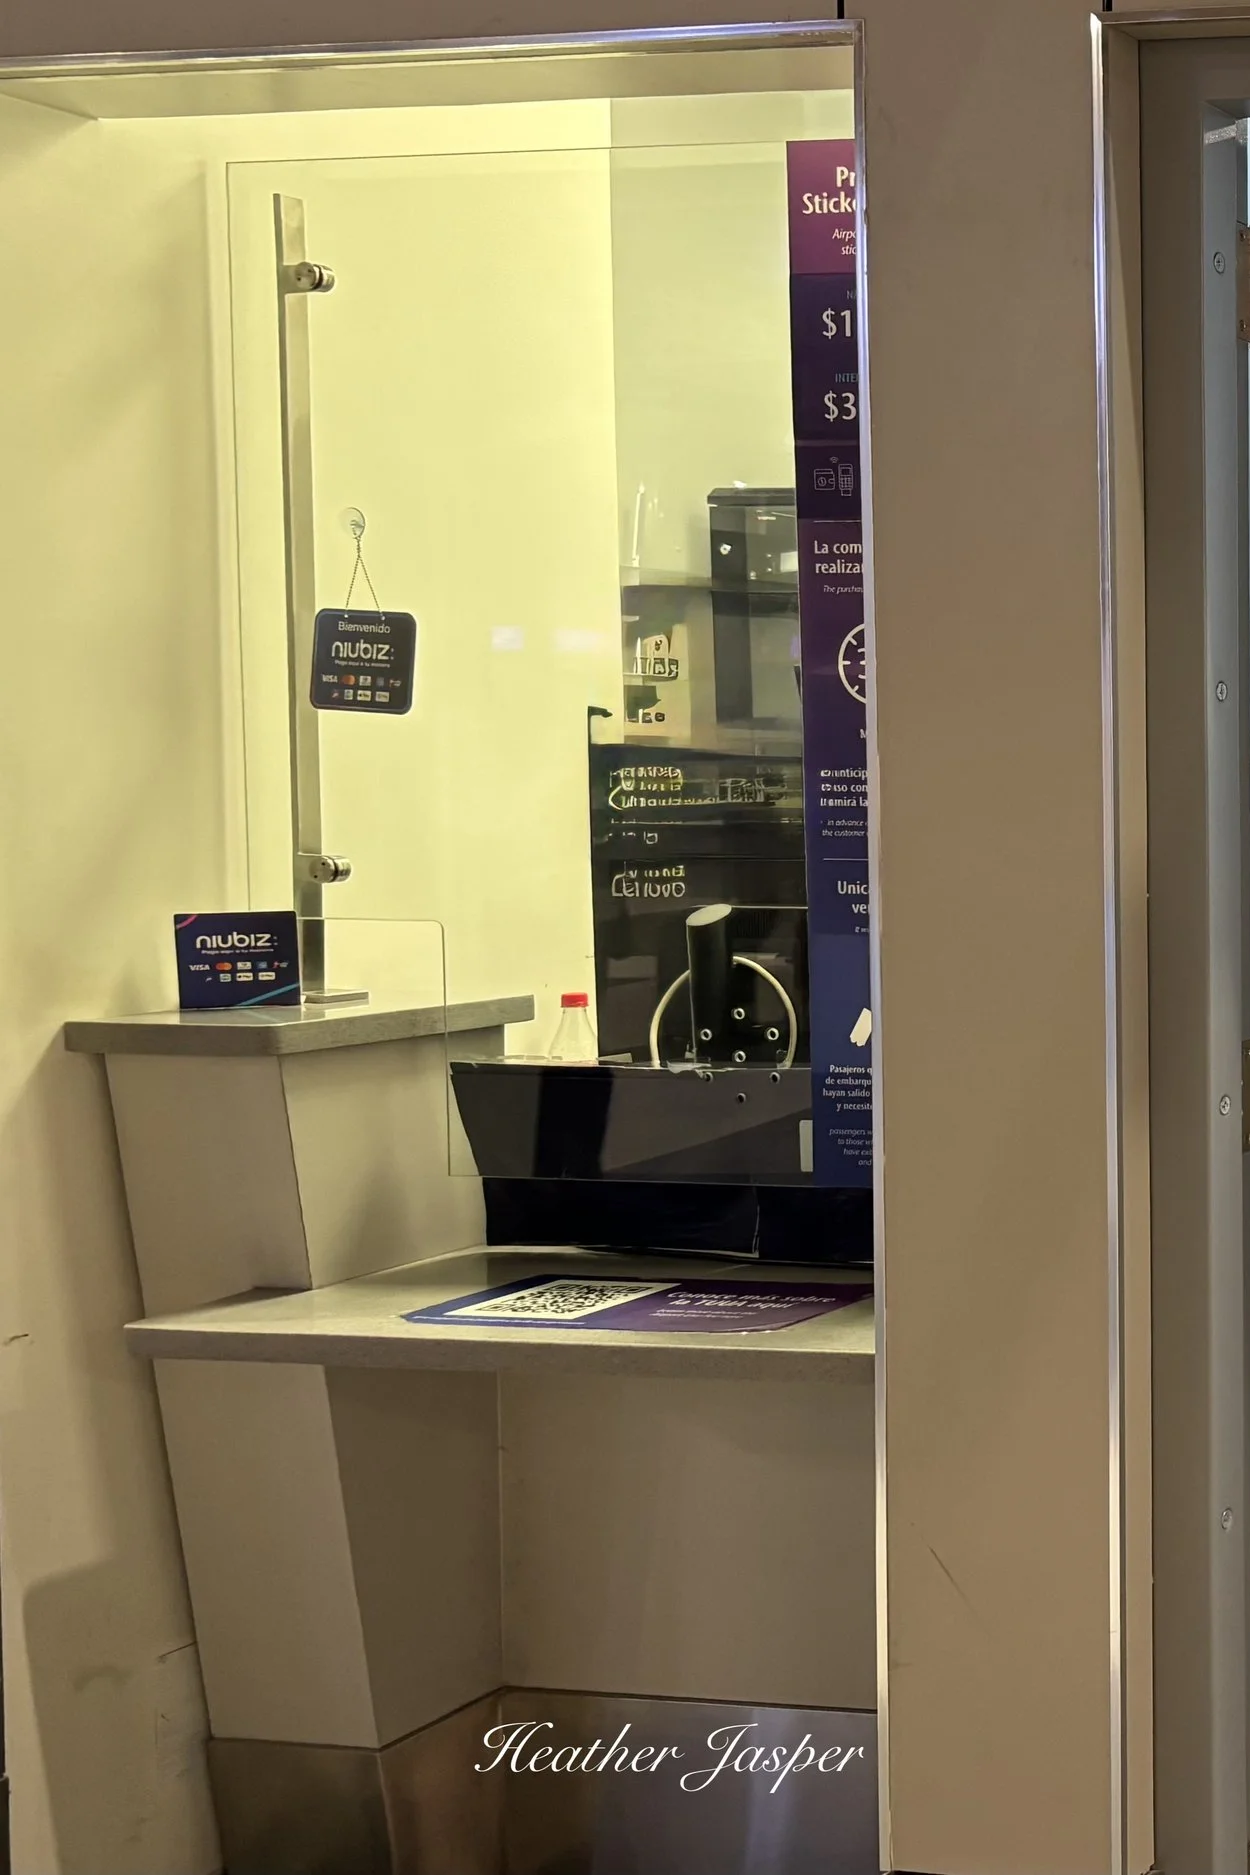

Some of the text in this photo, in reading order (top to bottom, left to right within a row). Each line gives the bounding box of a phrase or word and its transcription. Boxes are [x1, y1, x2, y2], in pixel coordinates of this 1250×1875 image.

[814, 540, 829, 554] La
[338, 621, 391, 633] Bienvenido
[829, 1064, 866, 1076] Pasajeros
[825, 1077, 835, 1085] de
[822, 1087, 871, 1098] hayan salido
